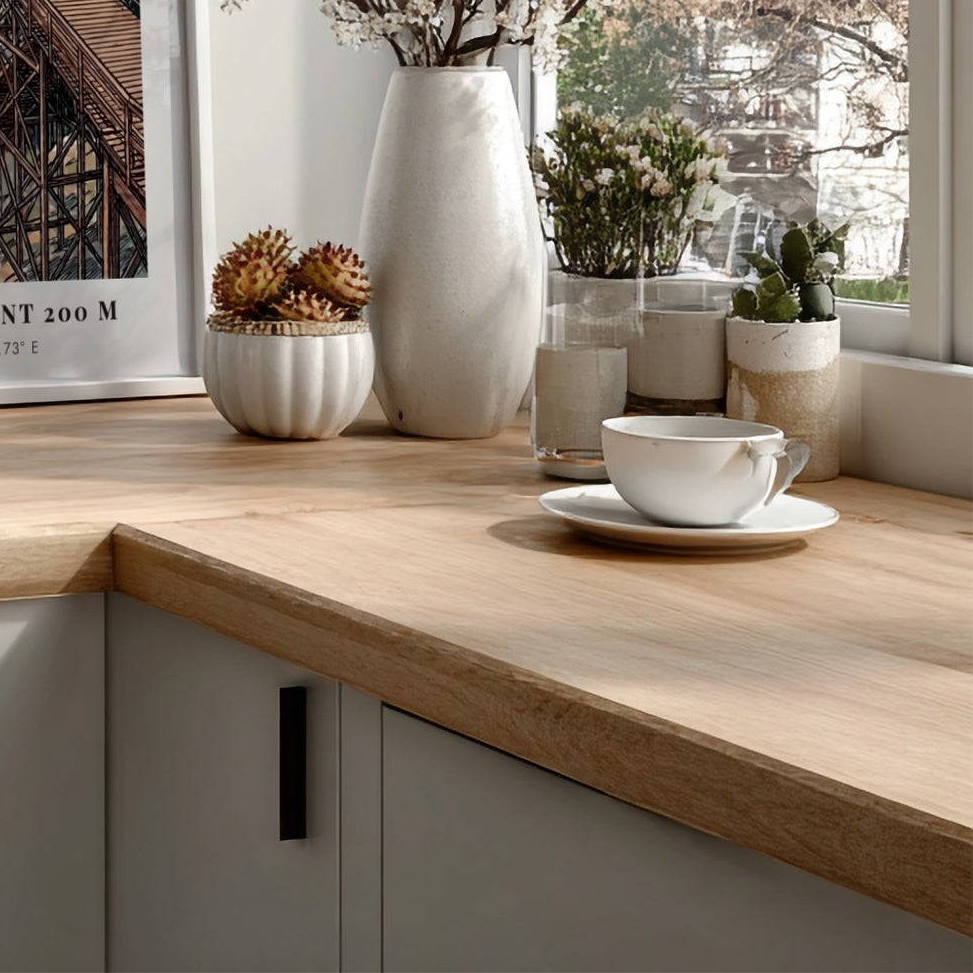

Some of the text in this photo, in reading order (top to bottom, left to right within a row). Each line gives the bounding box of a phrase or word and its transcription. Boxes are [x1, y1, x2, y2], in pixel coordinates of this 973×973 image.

[43, 305, 88, 324] 200
[98, 299, 118, 322] M
[31, 340, 39, 355] E
